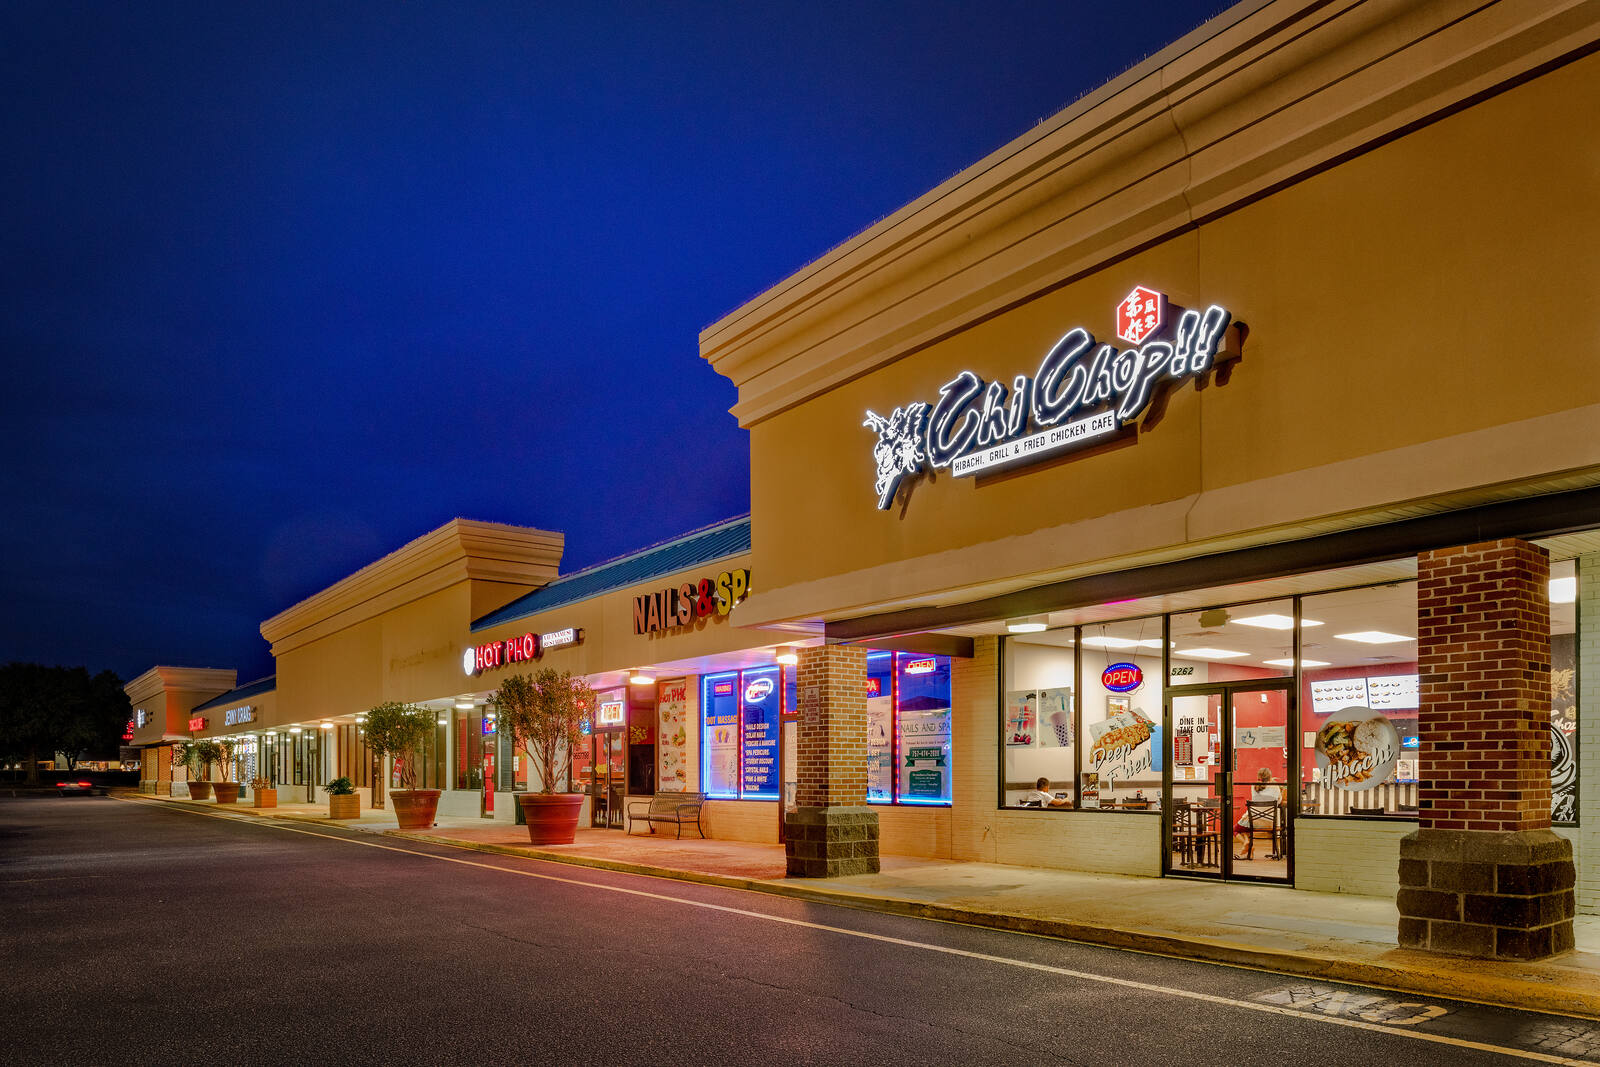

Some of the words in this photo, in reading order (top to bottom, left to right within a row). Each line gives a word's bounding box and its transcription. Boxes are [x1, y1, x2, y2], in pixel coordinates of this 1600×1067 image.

[927, 370, 1029, 468] Chi
[989, 447, 1010, 462] GRILL
[1014, 444, 1020, 455] &
[1023, 436, 1046, 451] FRIED
[1050, 423, 1086, 443] CHICKEN
[1091, 415, 1113, 431] CAFE
[632, 582, 692, 636] NAILS
[696, 577, 714, 618] &
[717, 565, 753, 617] SP
[475, 640, 503, 670] HOT
[506, 631, 537, 664] PHO
[906, 659, 935, 671] OPEN
[1171, 666, 1194, 676] 5262
[866, 679, 877, 692] PA
[1104, 668, 1137, 686] OPEN
[225, 709, 237, 726] JENNY
[237, 705, 251, 724] CRAIG
[717, 714, 738, 725] MASSAG
[1179, 717, 1194, 726] DINE
[1197, 716, 1205, 725] IN
[901, 723, 919, 733] NAILS
[921, 722, 936, 732] AND
[938, 722, 950, 732] SPA
[1179, 726, 1194, 734] TAKE
[1196, 725, 1209, 733] OUT
[1093, 743, 1133, 772] Deep
[1319, 744, 1395, 790] Hibachi
